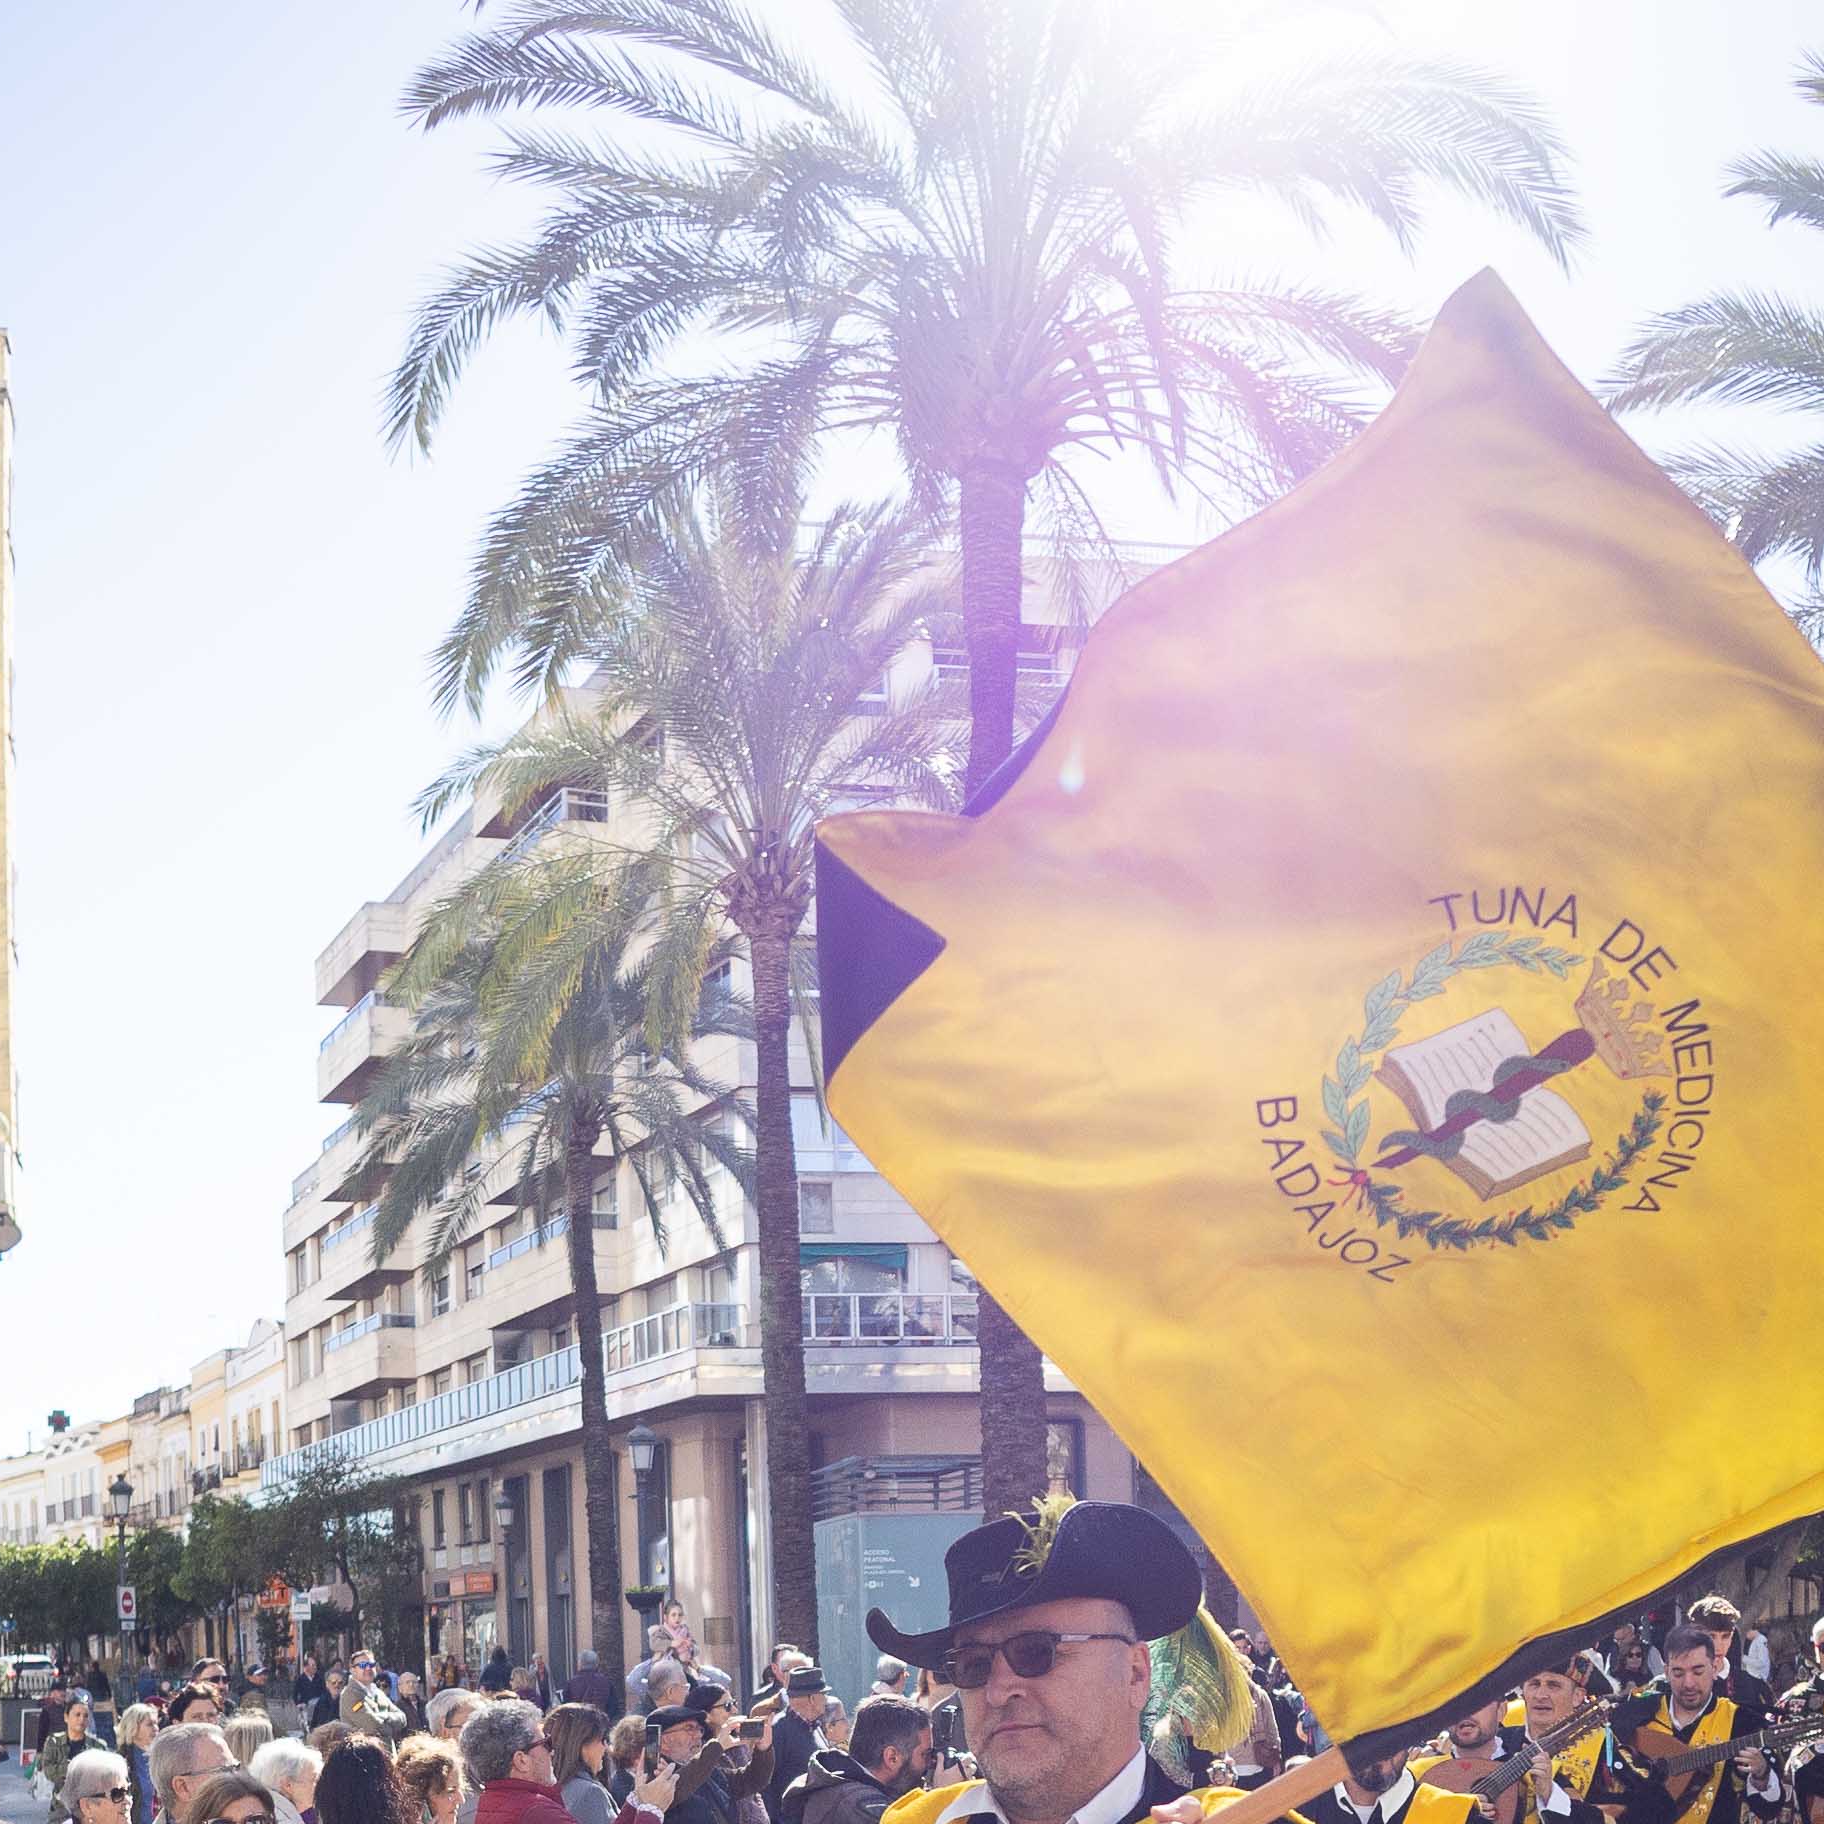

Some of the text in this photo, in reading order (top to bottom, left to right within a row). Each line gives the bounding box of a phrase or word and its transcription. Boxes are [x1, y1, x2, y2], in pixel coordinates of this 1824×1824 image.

[1428, 886, 1716, 1214] TUNA DE MEDICINA
[1255, 1095, 1413, 1284] BADAJOZ
